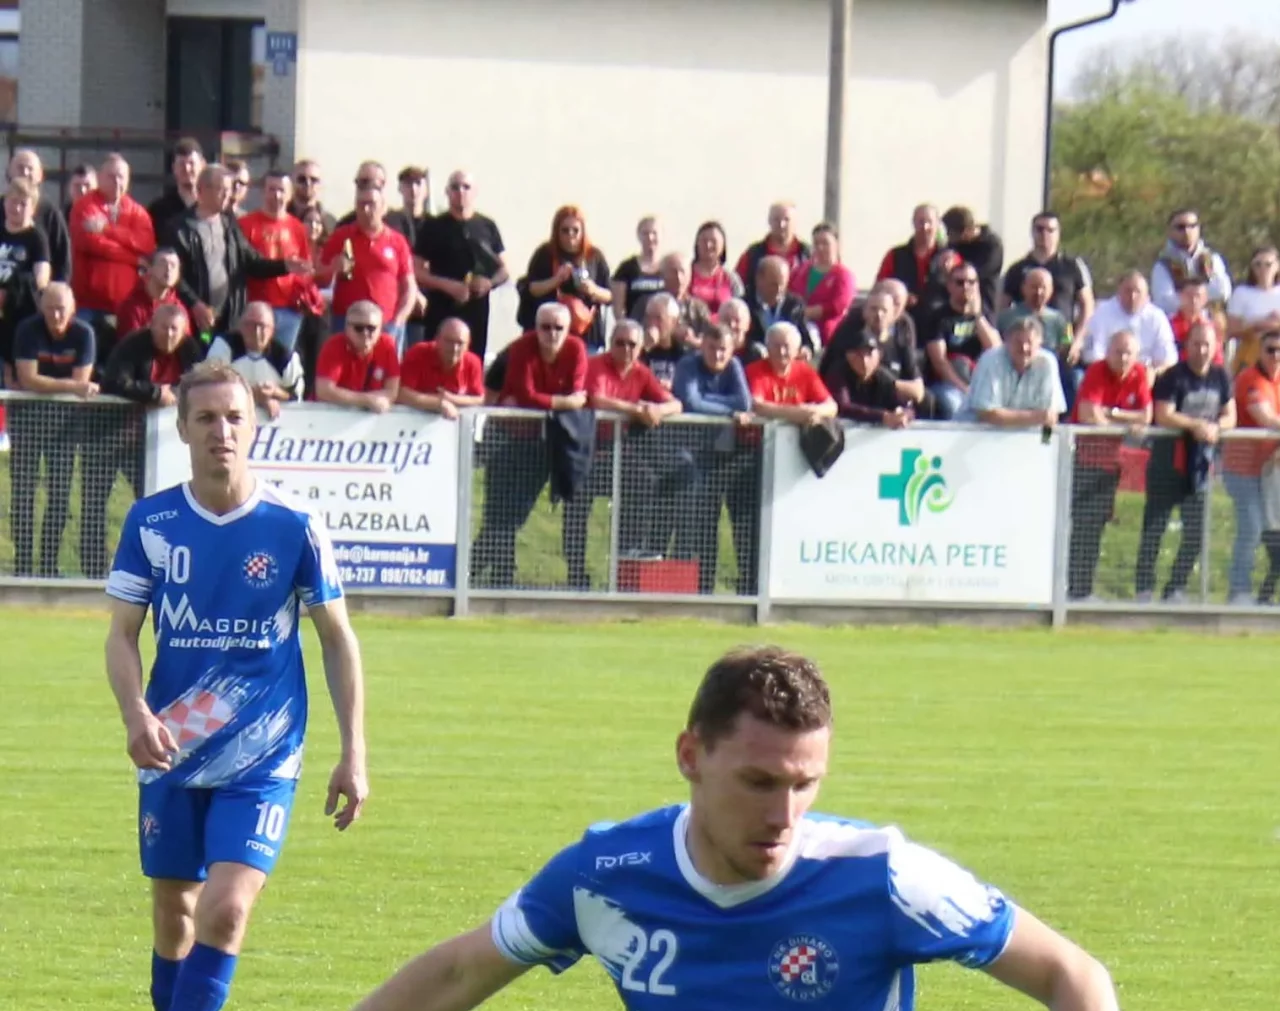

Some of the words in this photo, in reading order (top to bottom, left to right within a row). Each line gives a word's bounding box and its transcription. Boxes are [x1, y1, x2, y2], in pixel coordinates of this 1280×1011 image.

[247, 424, 433, 473] Harmonija
[344, 481, 392, 501] CAR
[319, 510, 431, 533] LAZBALA
[799, 540, 939, 567] LJEKARNA
[946, 543, 1008, 568] PETE
[255, 802, 285, 842] 10
[596, 850, 652, 870] FOTEX
[621, 928, 678, 996] 22
